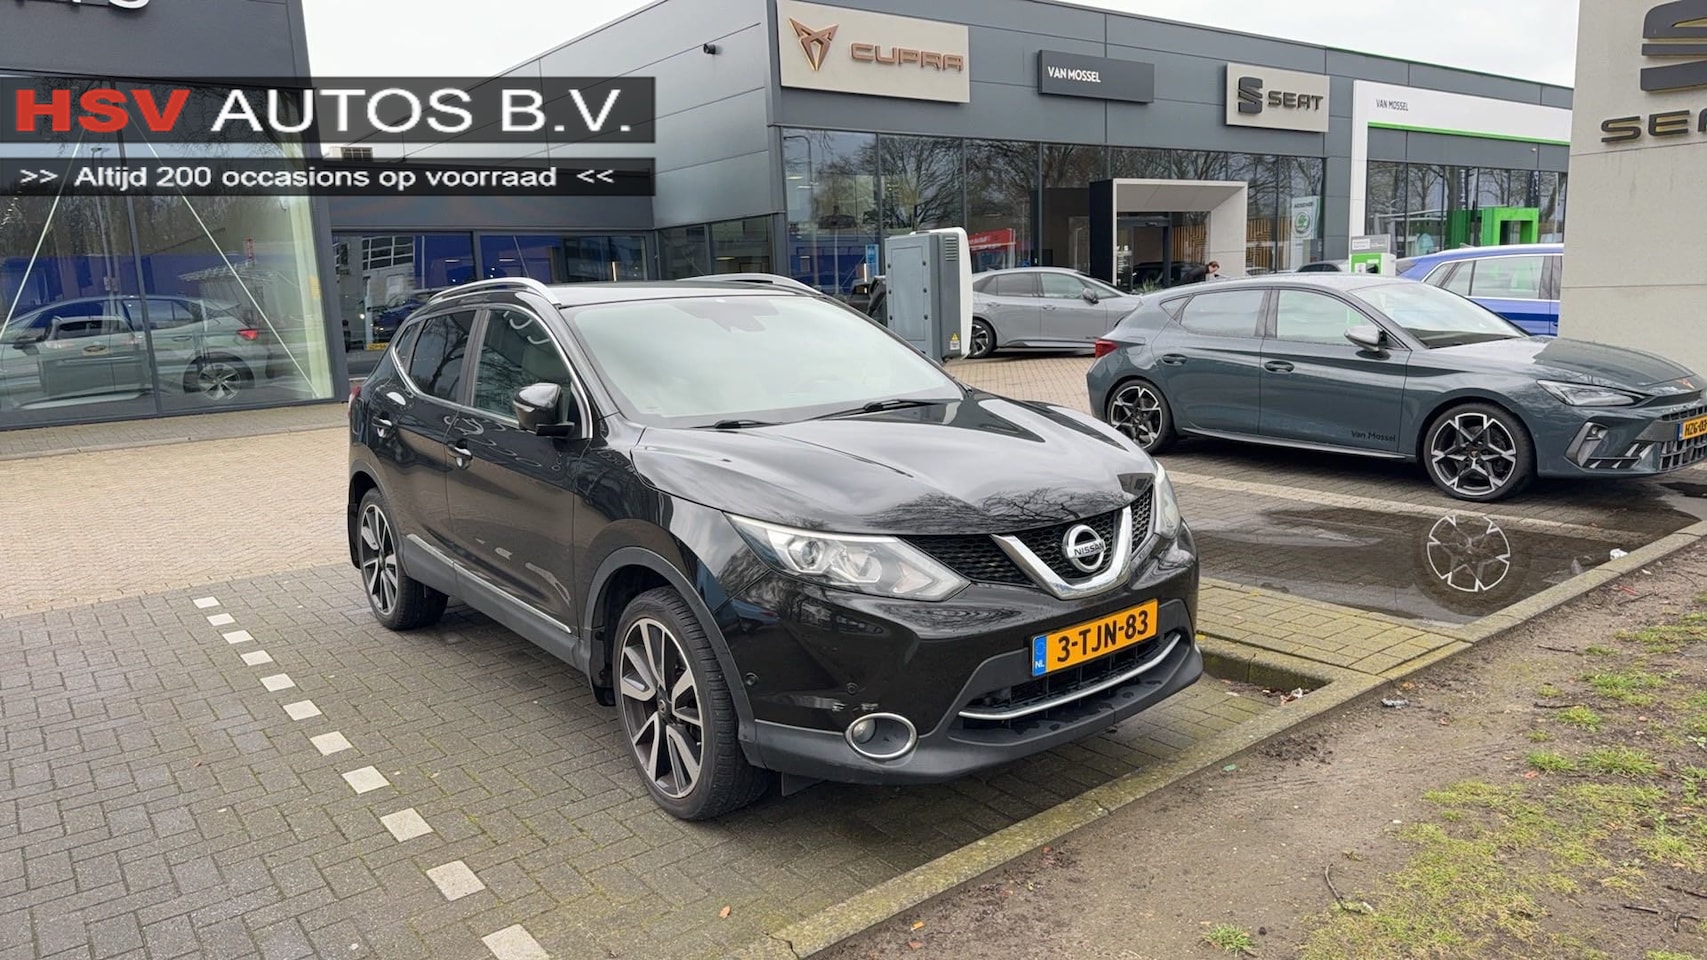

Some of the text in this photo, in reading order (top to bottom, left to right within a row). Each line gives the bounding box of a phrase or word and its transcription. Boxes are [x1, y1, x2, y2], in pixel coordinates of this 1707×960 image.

[850, 42, 964, 72] CUPRA
[1047, 66, 1101, 83] VAN MOSSEL
[1268, 90, 1324, 111] SEAT
[1375, 99, 1409, 111] VAN MOSSEL
[1601, 108, 1707, 142] SE
[1351, 430, 1396, 442] Van Mossel
[1073, 541, 1104, 556] NISSAN
[1056, 610, 1148, 663] 3-TJN-83
[1034, 659, 1045, 669] NL
